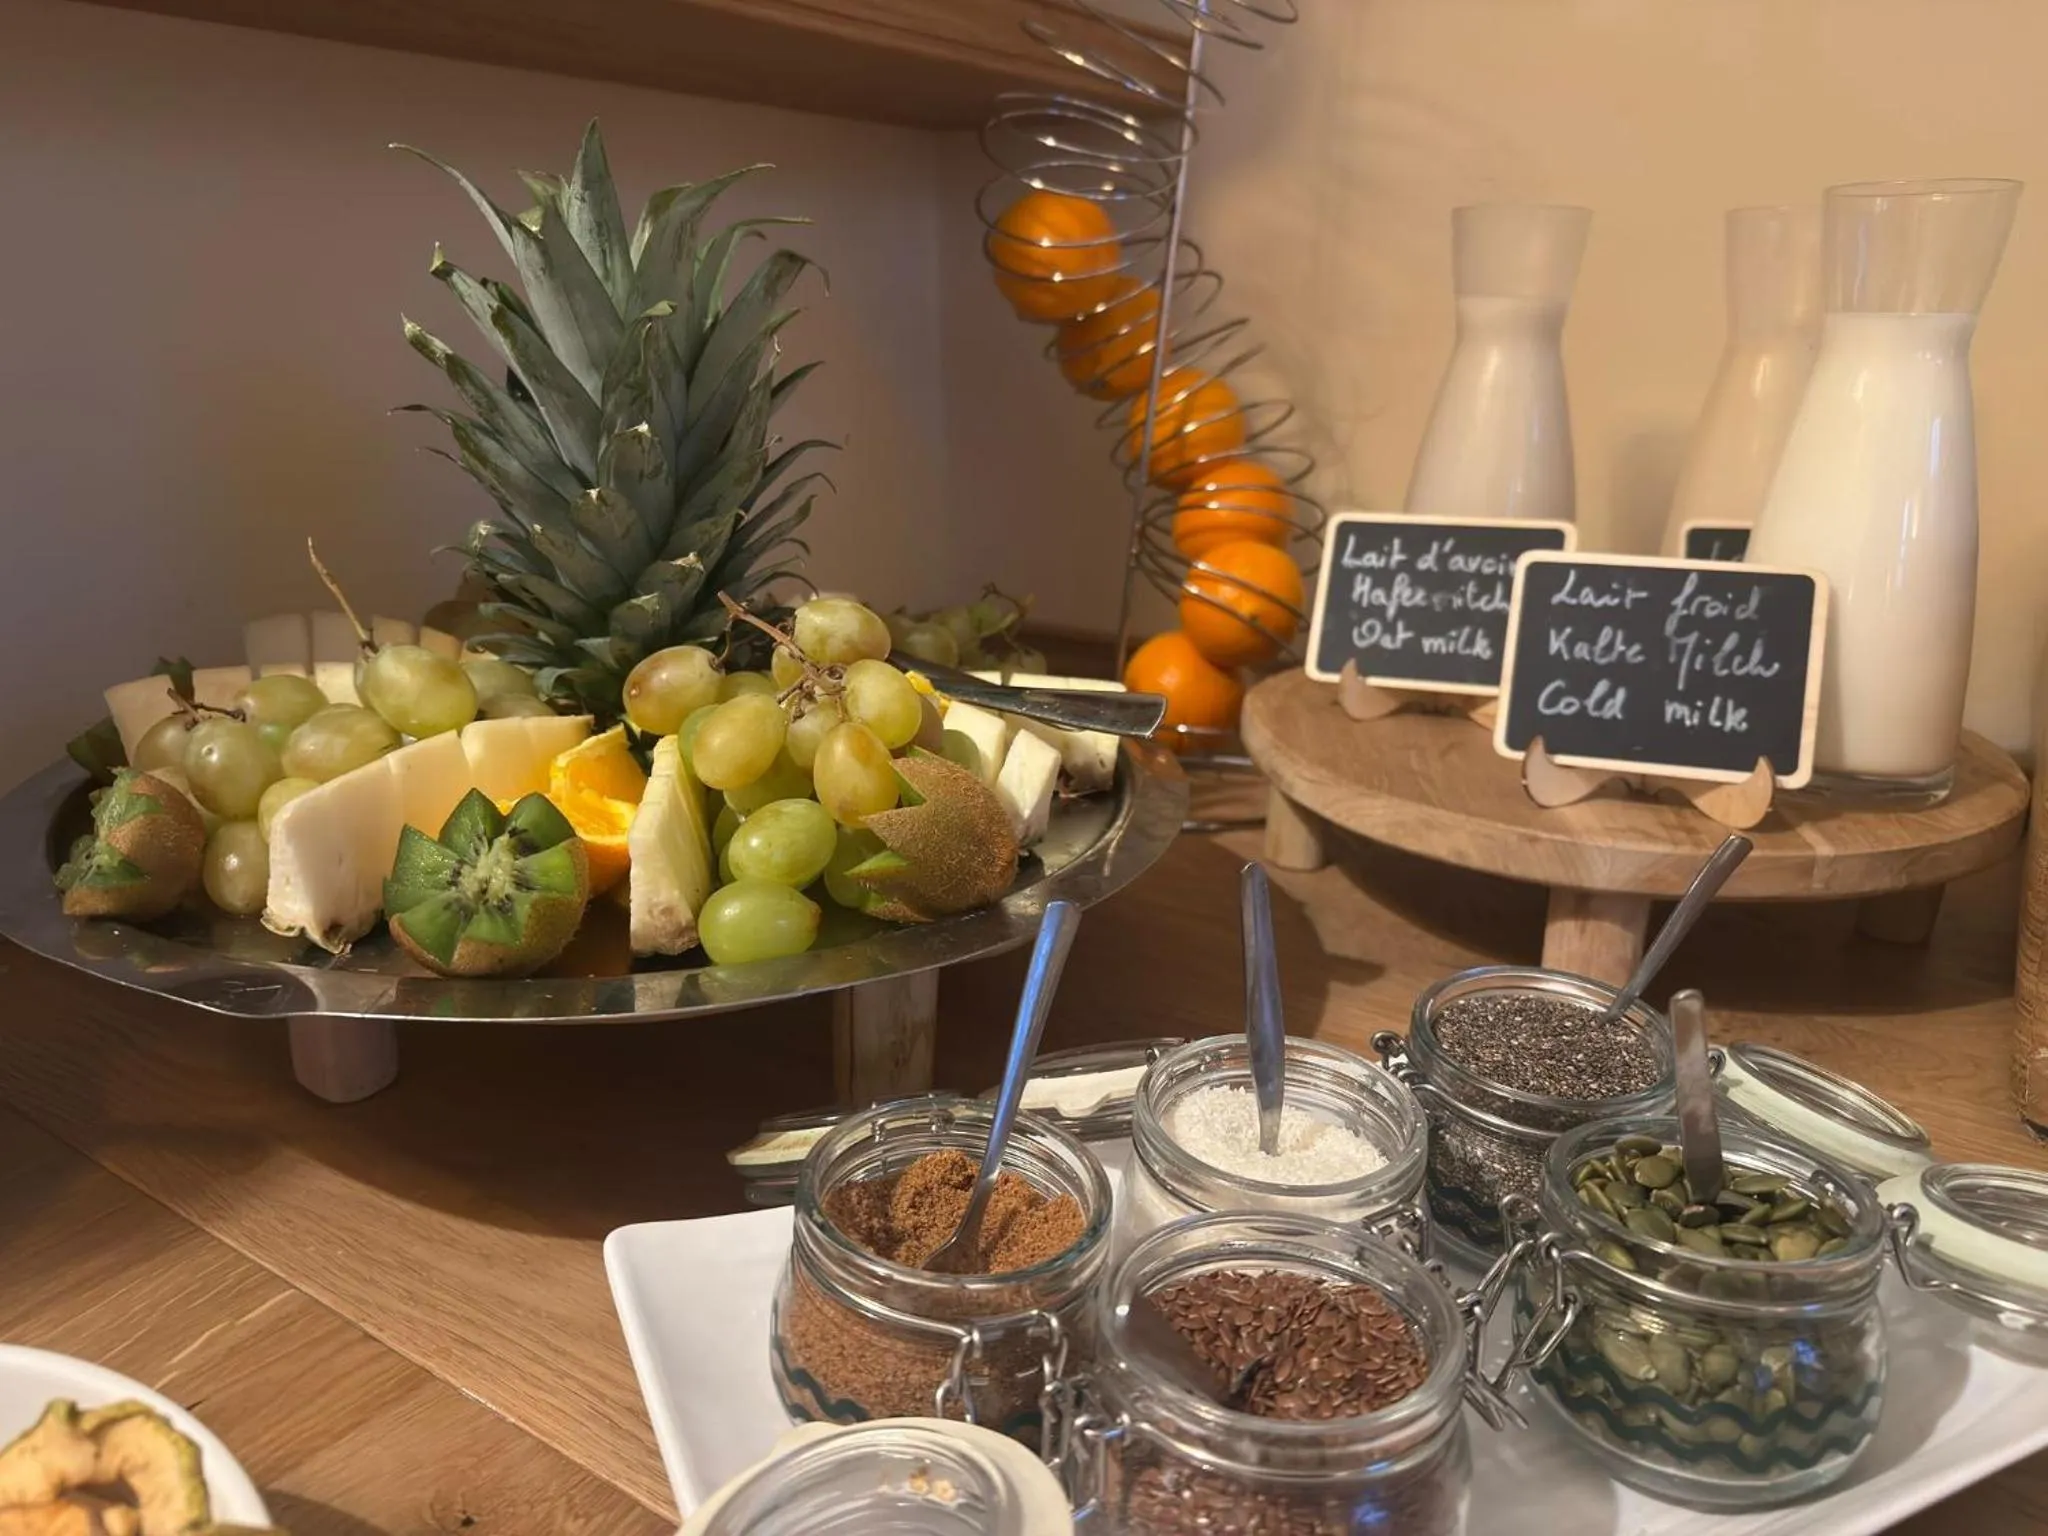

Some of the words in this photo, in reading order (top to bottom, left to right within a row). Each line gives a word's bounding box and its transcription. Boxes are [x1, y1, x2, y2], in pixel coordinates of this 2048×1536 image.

[1341, 534, 1408, 569] Lait
[1551, 570, 1648, 609] Lait
[1664, 572, 1761, 637] froid
[1352, 618, 1415, 650] Oat
[1421, 626, 1494, 660] milk
[1549, 625, 1645, 665] Kalte
[1537, 679, 1628, 719] Cold
[1664, 696, 1749, 733] milk
